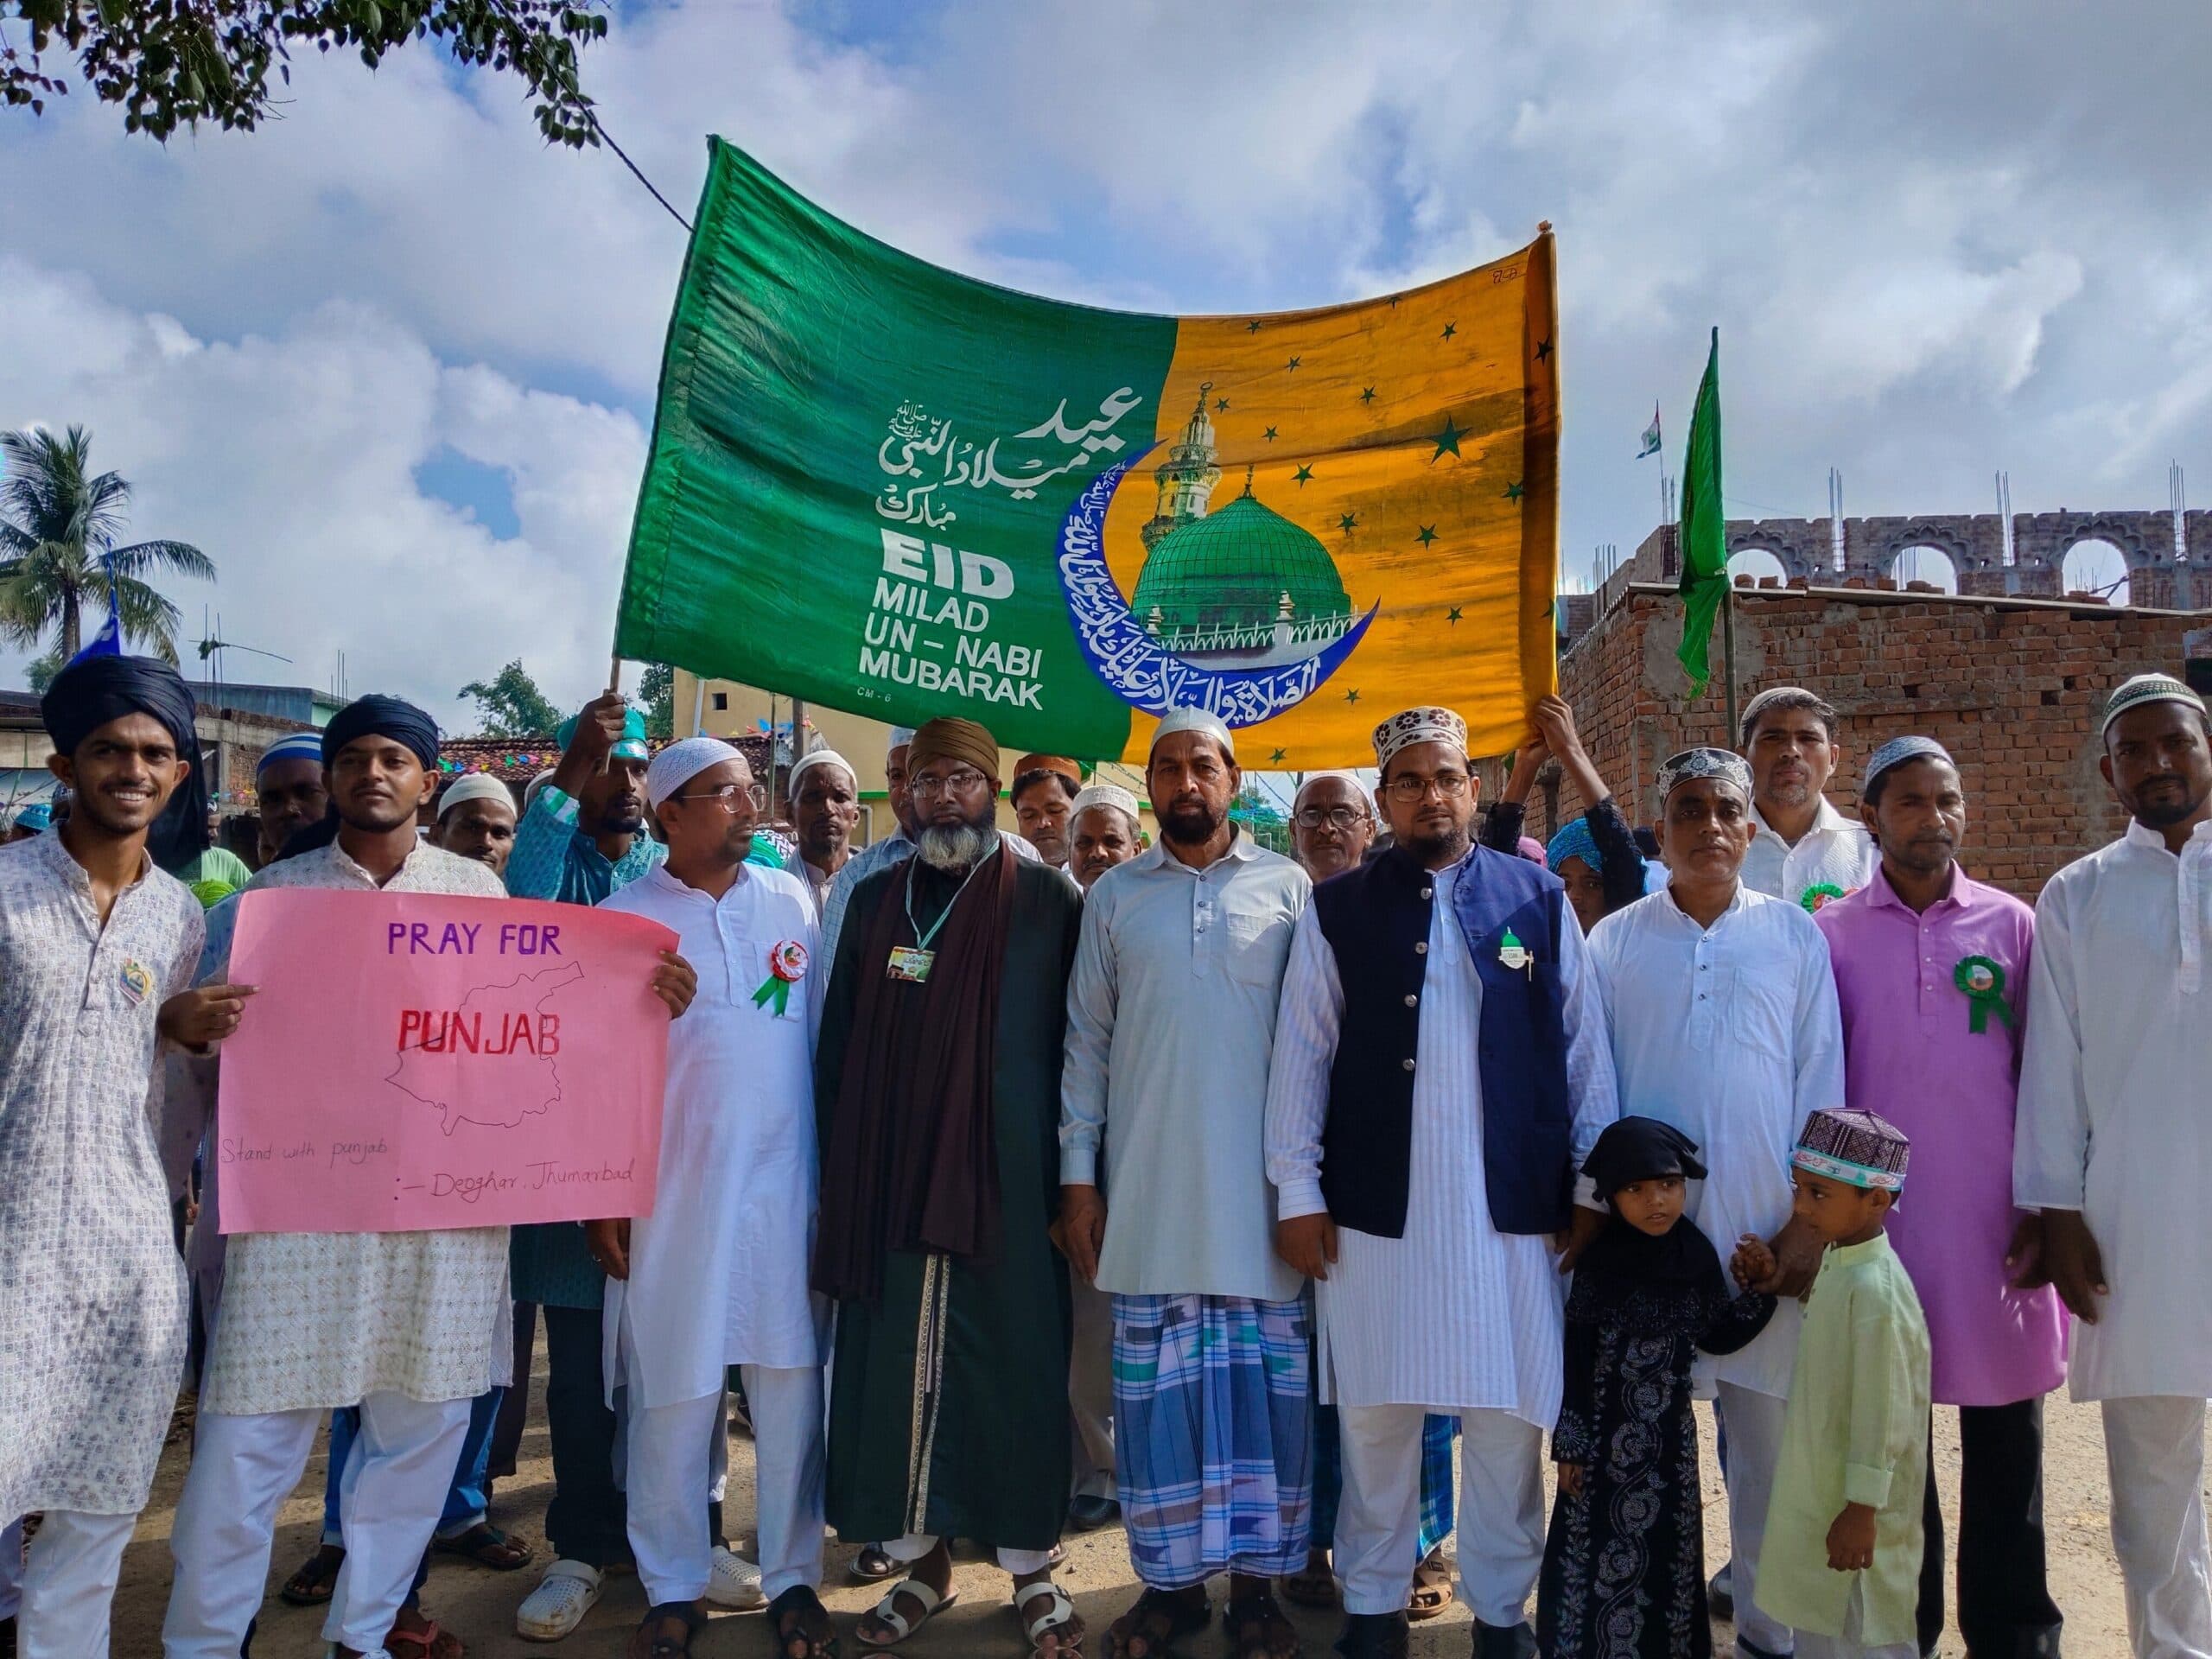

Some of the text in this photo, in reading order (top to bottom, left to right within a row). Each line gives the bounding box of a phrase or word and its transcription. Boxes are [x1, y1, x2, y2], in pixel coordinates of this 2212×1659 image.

[880, 527, 1015, 601] EID
[872, 577, 990, 633] MILAD
[859, 646, 1044, 710] MUBARAK
[954, 635, 1043, 679] NABI
[387, 922, 563, 957] PRAY FOR
[397, 1008, 562, 1056] PUNJAB
[220, 1137, 273, 1165] Stand
[281, 1139, 316, 1160] with
